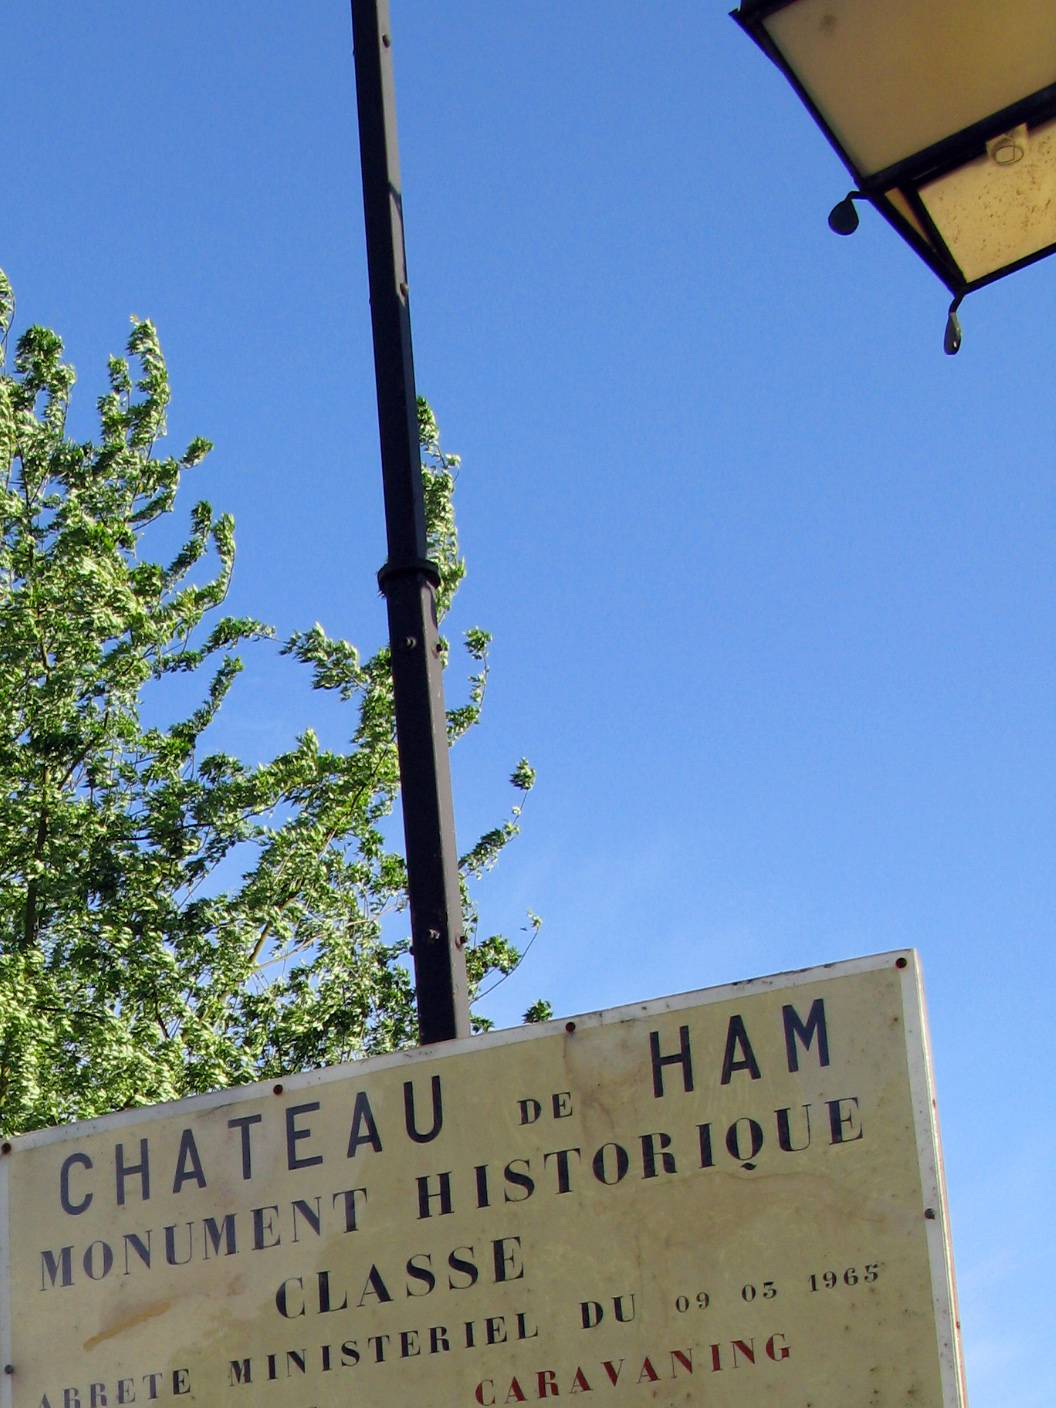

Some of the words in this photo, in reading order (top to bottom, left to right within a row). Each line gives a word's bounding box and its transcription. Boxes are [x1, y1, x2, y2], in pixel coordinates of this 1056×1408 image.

[60, 1076, 445, 1215] CHATEAU
[517, 1091, 574, 1126] DE
[650, 998, 831, 1099] HAM
[39, 1187, 369, 1291] MONUMENT
[416, 1096, 865, 1220] HISTORIQUE
[227, 1312, 538, 1387] MINISTERIEL
[579, 1293, 638, 1330] DU
[674, 1291, 711, 1314] 09
[807, 1263, 879, 1292] 1965
[274, 1236, 525, 1320] CLASSE
[474, 1333, 792, 1408] CARAVANING
